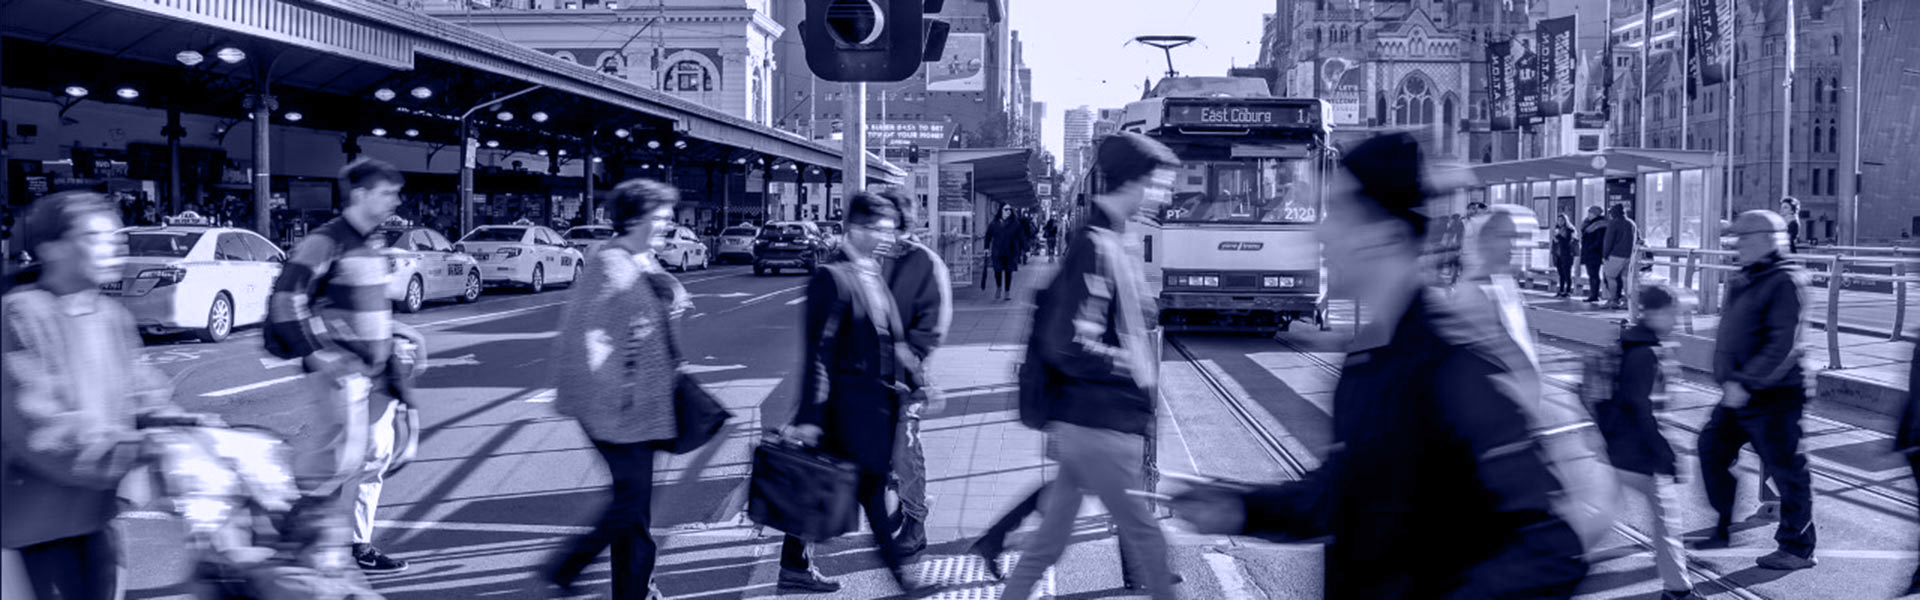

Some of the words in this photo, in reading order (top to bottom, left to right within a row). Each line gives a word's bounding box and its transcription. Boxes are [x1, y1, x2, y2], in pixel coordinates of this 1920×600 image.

[1201, 108, 1228, 123] East
[1230, 108, 1271, 123] Coburg
[1297, 108, 1304, 123] 1
[1284, 207, 1315, 220] 2120
